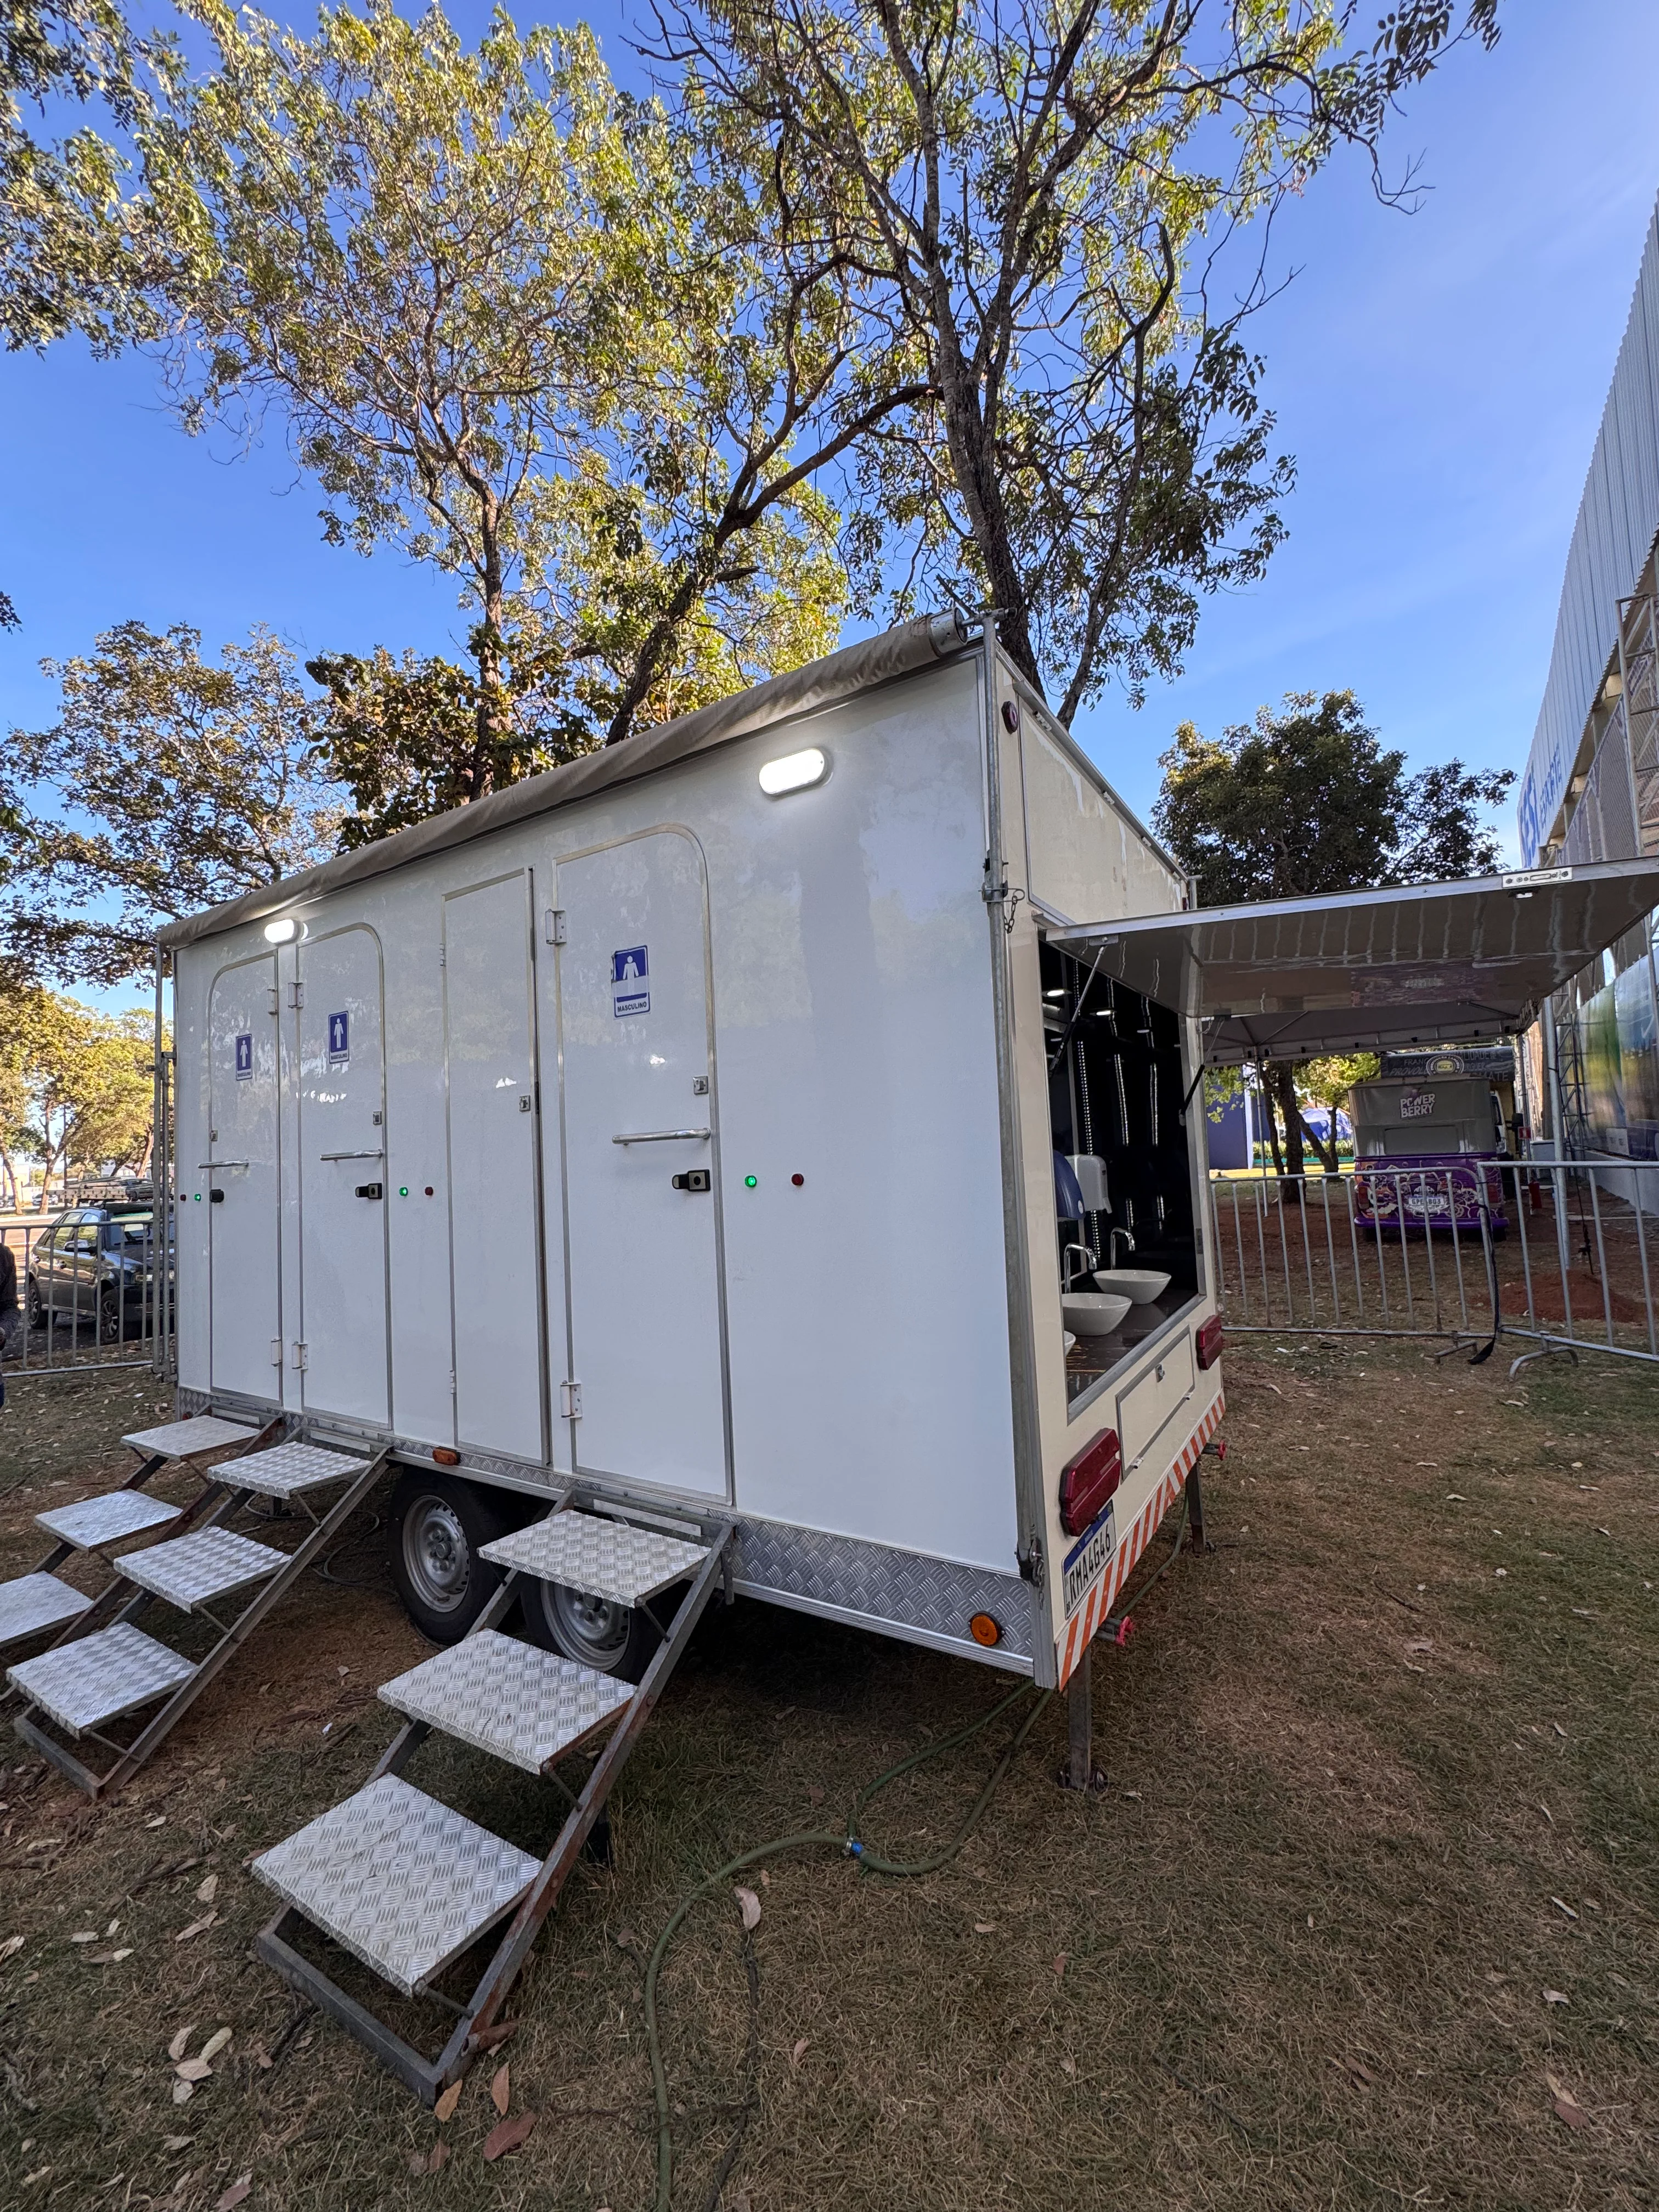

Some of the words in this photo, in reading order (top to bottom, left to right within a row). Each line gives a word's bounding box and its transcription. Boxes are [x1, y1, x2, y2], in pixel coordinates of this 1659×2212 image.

[617, 1001, 647, 1012] MASCULINO
[1401, 1093, 1436, 1108] POWER
[1401, 1102, 1434, 1118] BERRY
[1069, 1523, 1110, 1605] RMA4G46
